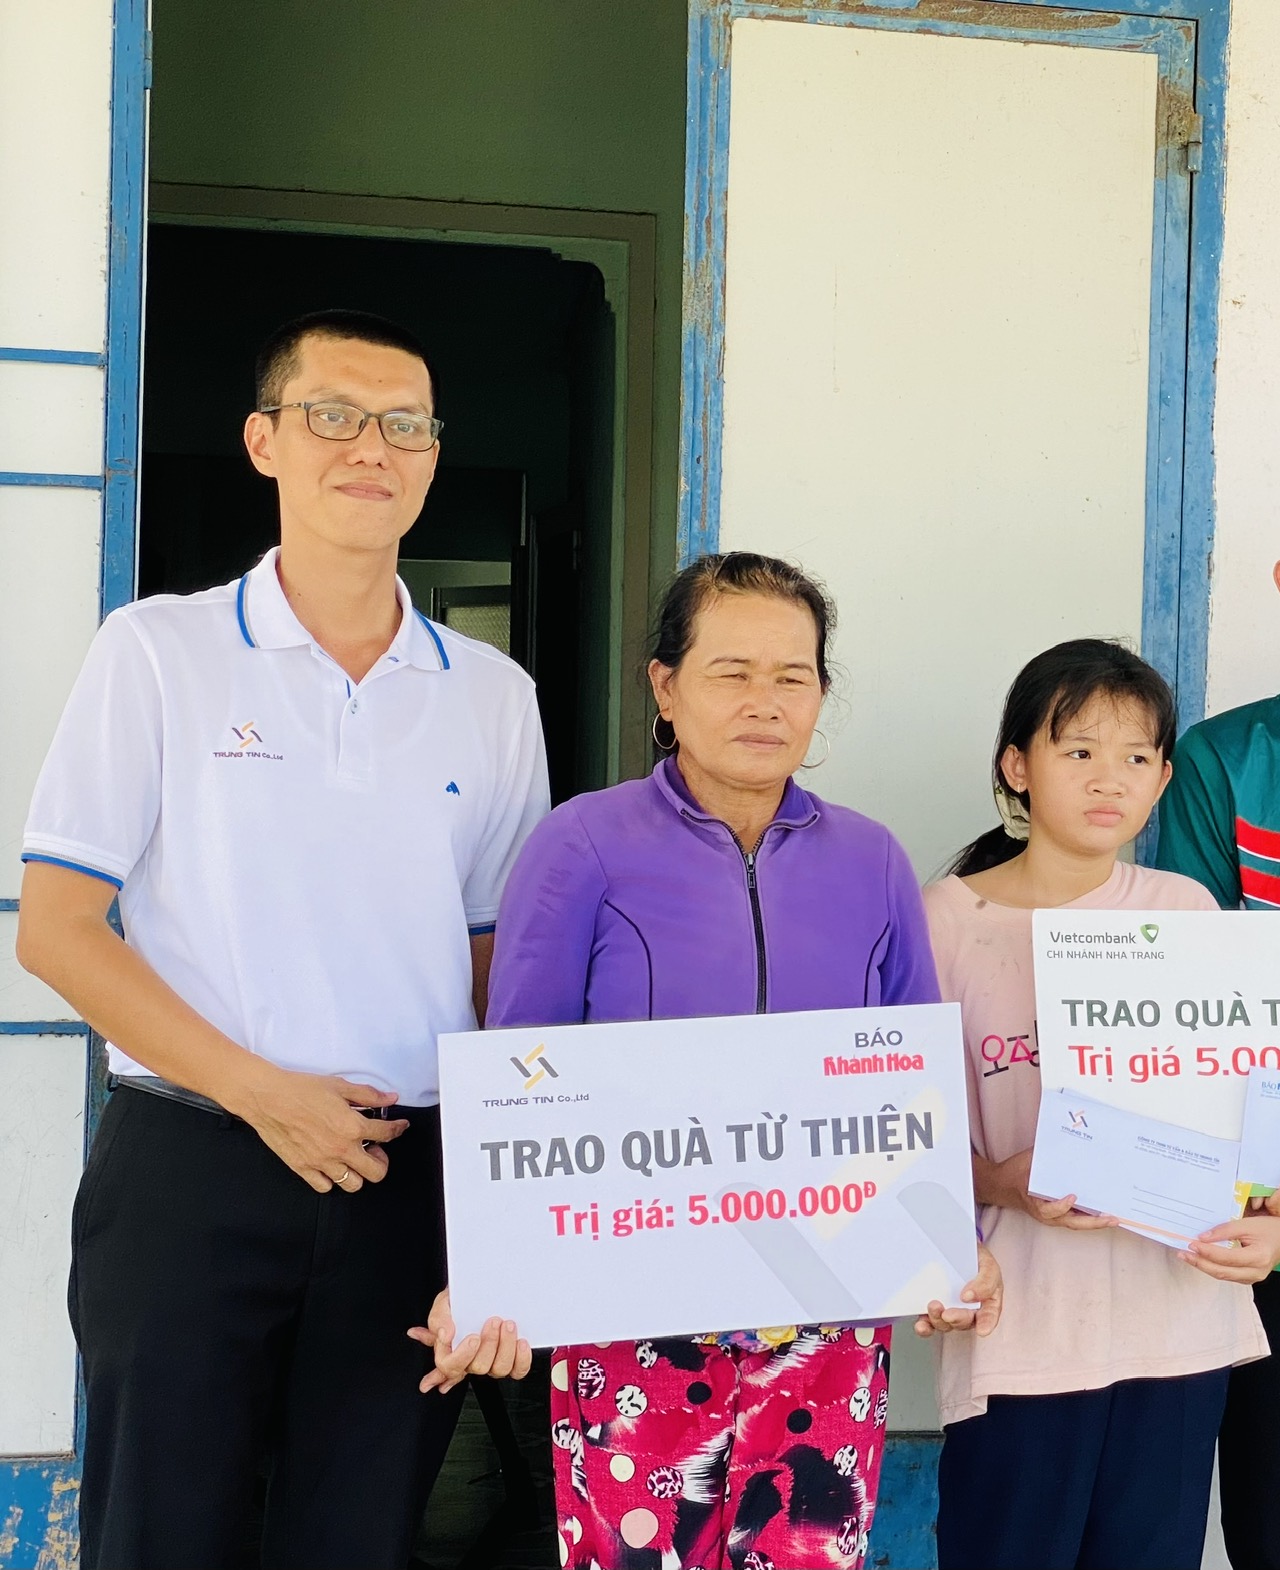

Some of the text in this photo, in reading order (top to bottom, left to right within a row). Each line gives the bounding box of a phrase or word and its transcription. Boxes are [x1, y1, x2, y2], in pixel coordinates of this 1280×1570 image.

[1050, 932, 1136, 944] Vietcombank
[1046, 948, 1165, 960] CHI NHÁNH NHA TRANG
[1062, 999, 1161, 1028] TRAO
[1175, 991, 1250, 1031] QUÀ
[854, 1027, 903, 1048] BÁO
[1068, 1045, 1113, 1082] Trị
[1129, 1045, 1181, 1082] giá
[483, 1094, 590, 1107] TRUNG TIN Co.,Ltd
[480, 1103, 934, 1181] TRAO QUÀ TỪ THIỆN
[549, 1203, 600, 1241] Trị
[612, 1199, 675, 1238] giá:
